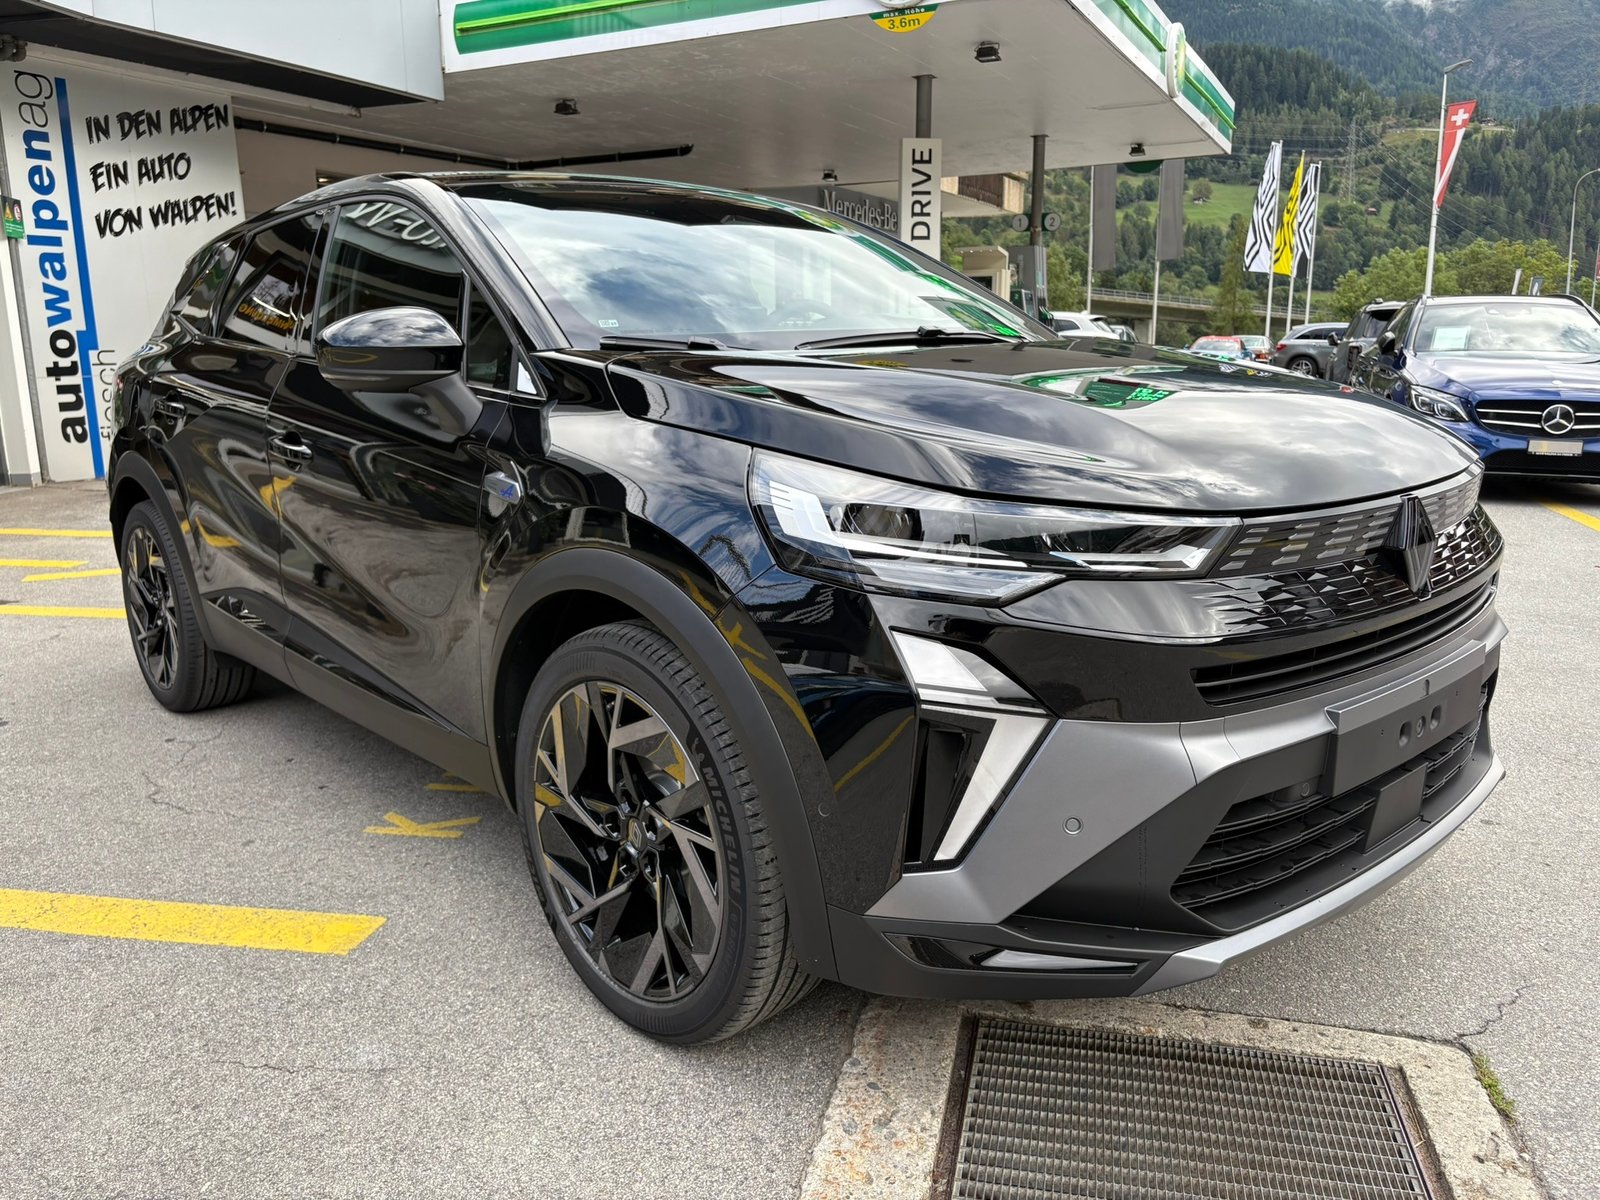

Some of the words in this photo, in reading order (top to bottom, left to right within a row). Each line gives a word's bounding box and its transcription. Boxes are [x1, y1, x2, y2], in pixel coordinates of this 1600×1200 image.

[888, 17, 921, 29] 3.6m
[85, 114, 111, 144] IN
[116, 109, 162, 141] DEN
[169, 103, 229, 136] ALPEN
[89, 161, 129, 193] EIN
[137, 152, 191, 186] AUTO
[94, 206, 143, 239] VON
[149, 191, 237, 230] WALPEN!
[911, 148, 932, 242] DRIVE
[1049, 217, 1055, 227] 2
[702, 767, 742, 894] MICHELIN
